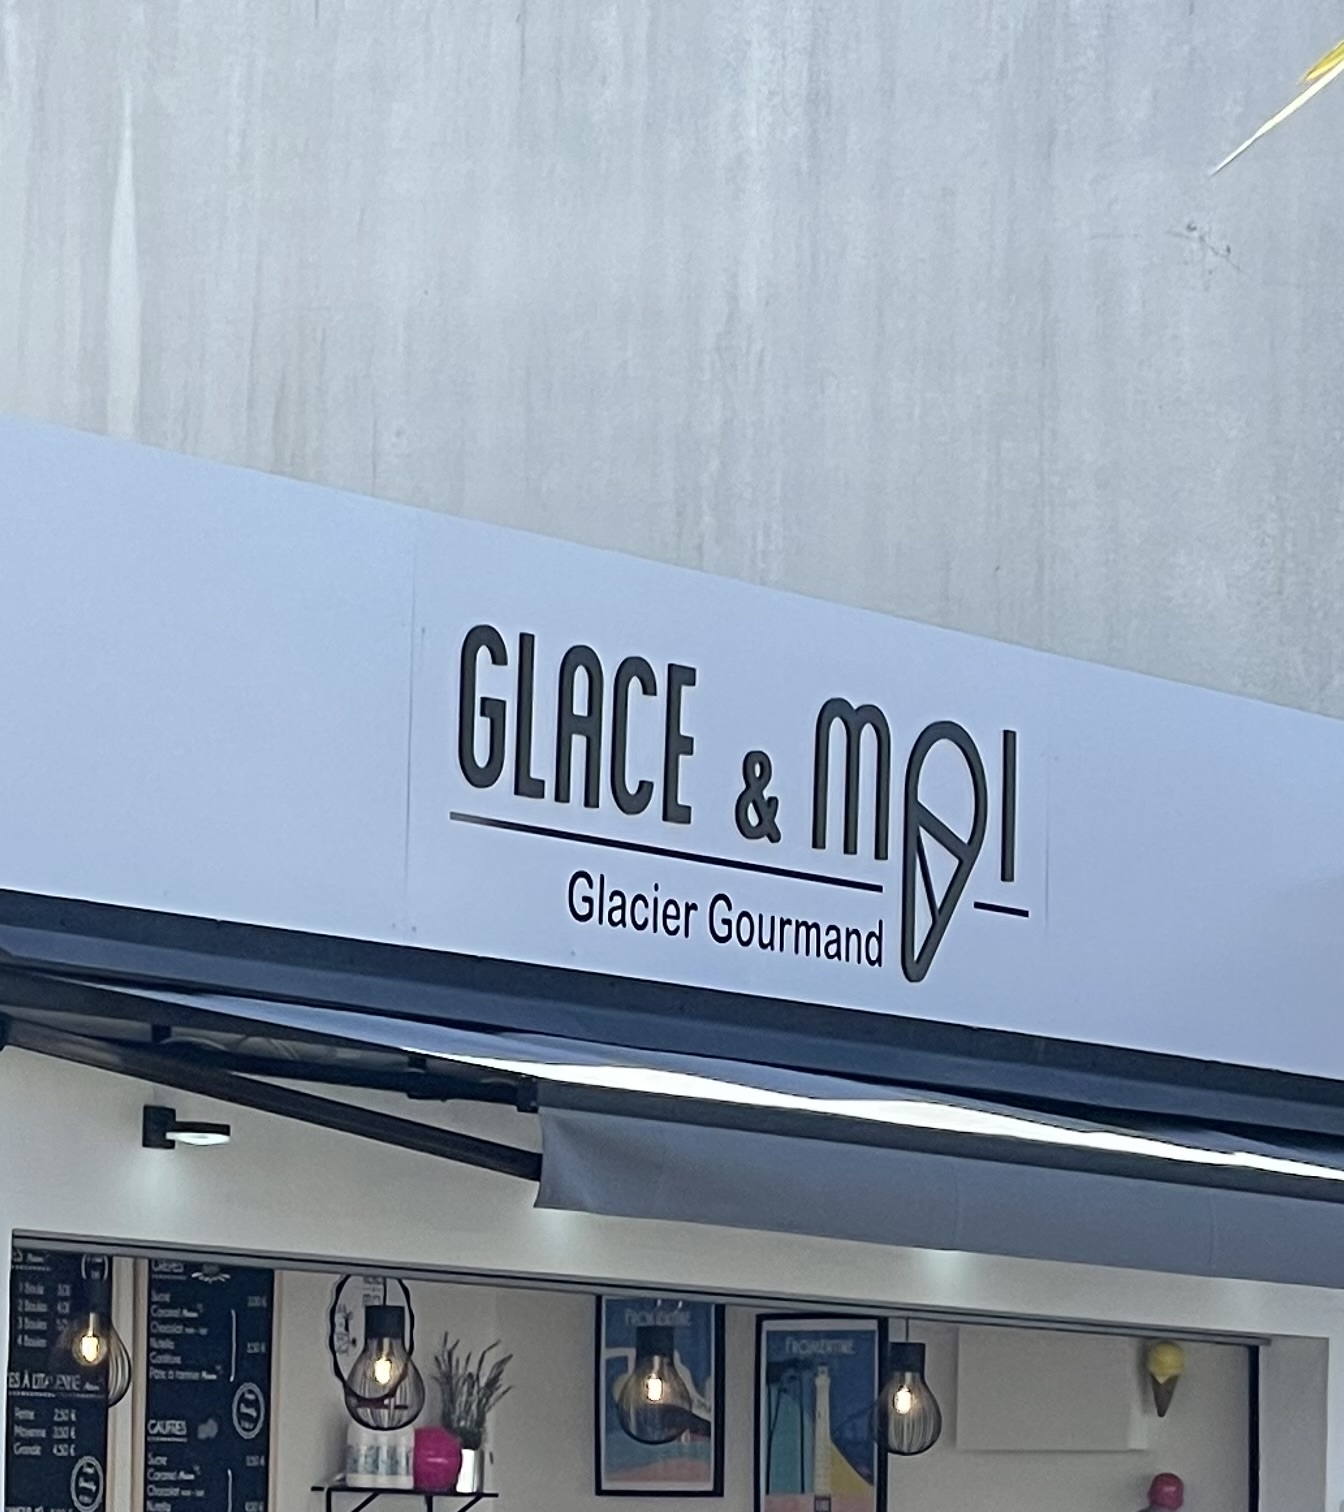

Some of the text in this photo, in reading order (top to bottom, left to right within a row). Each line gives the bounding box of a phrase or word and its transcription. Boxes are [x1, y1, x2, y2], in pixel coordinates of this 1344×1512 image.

[457, 624, 1017, 983] GLACE & MOI
[567, 871, 883, 967] Glacier Gourmand
